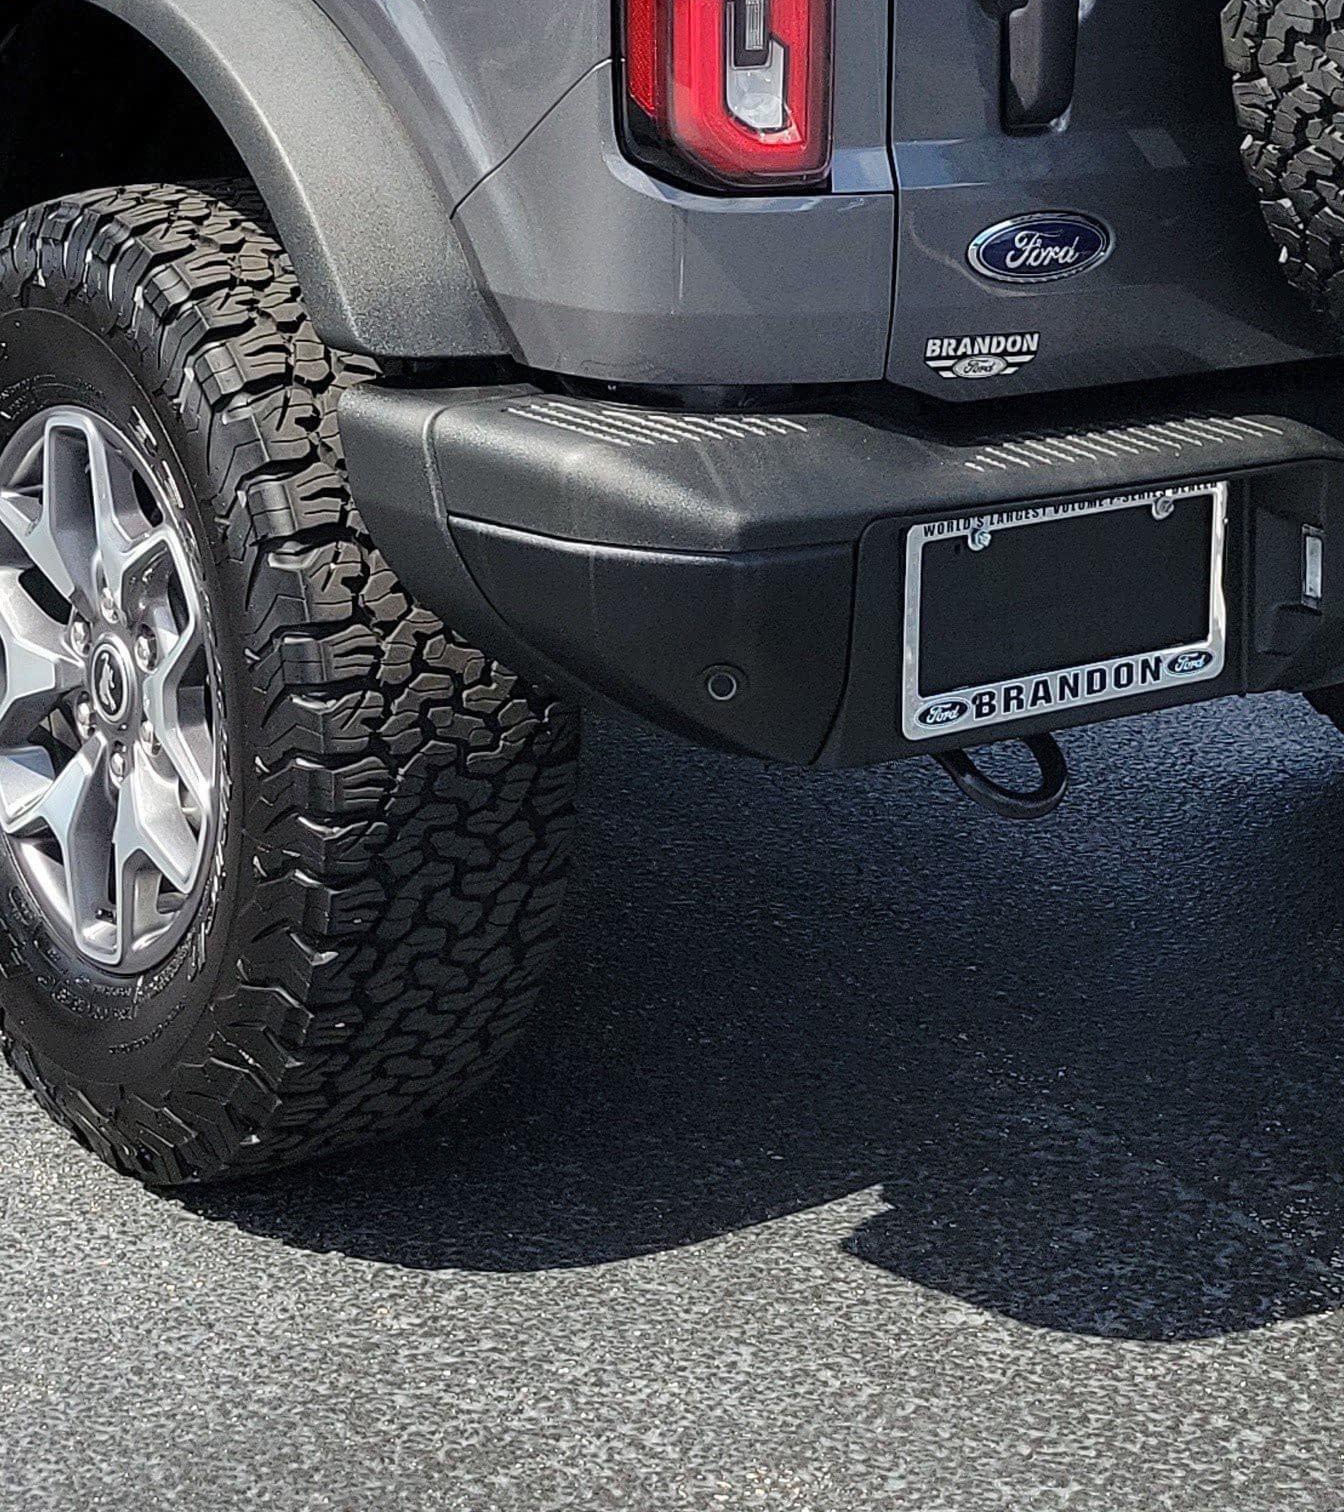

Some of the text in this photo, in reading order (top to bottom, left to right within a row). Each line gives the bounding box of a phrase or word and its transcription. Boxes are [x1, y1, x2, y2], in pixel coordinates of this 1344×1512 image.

[1005, 229, 1080, 269] Ford
[925, 333, 1040, 357] BRANDON
[963, 360, 997, 374] Ford
[923, 516, 984, 537] WORLD'S
[988, 508, 1048, 526] LARGEST
[925, 651, 1207, 724] Ford BRANDON Ford
